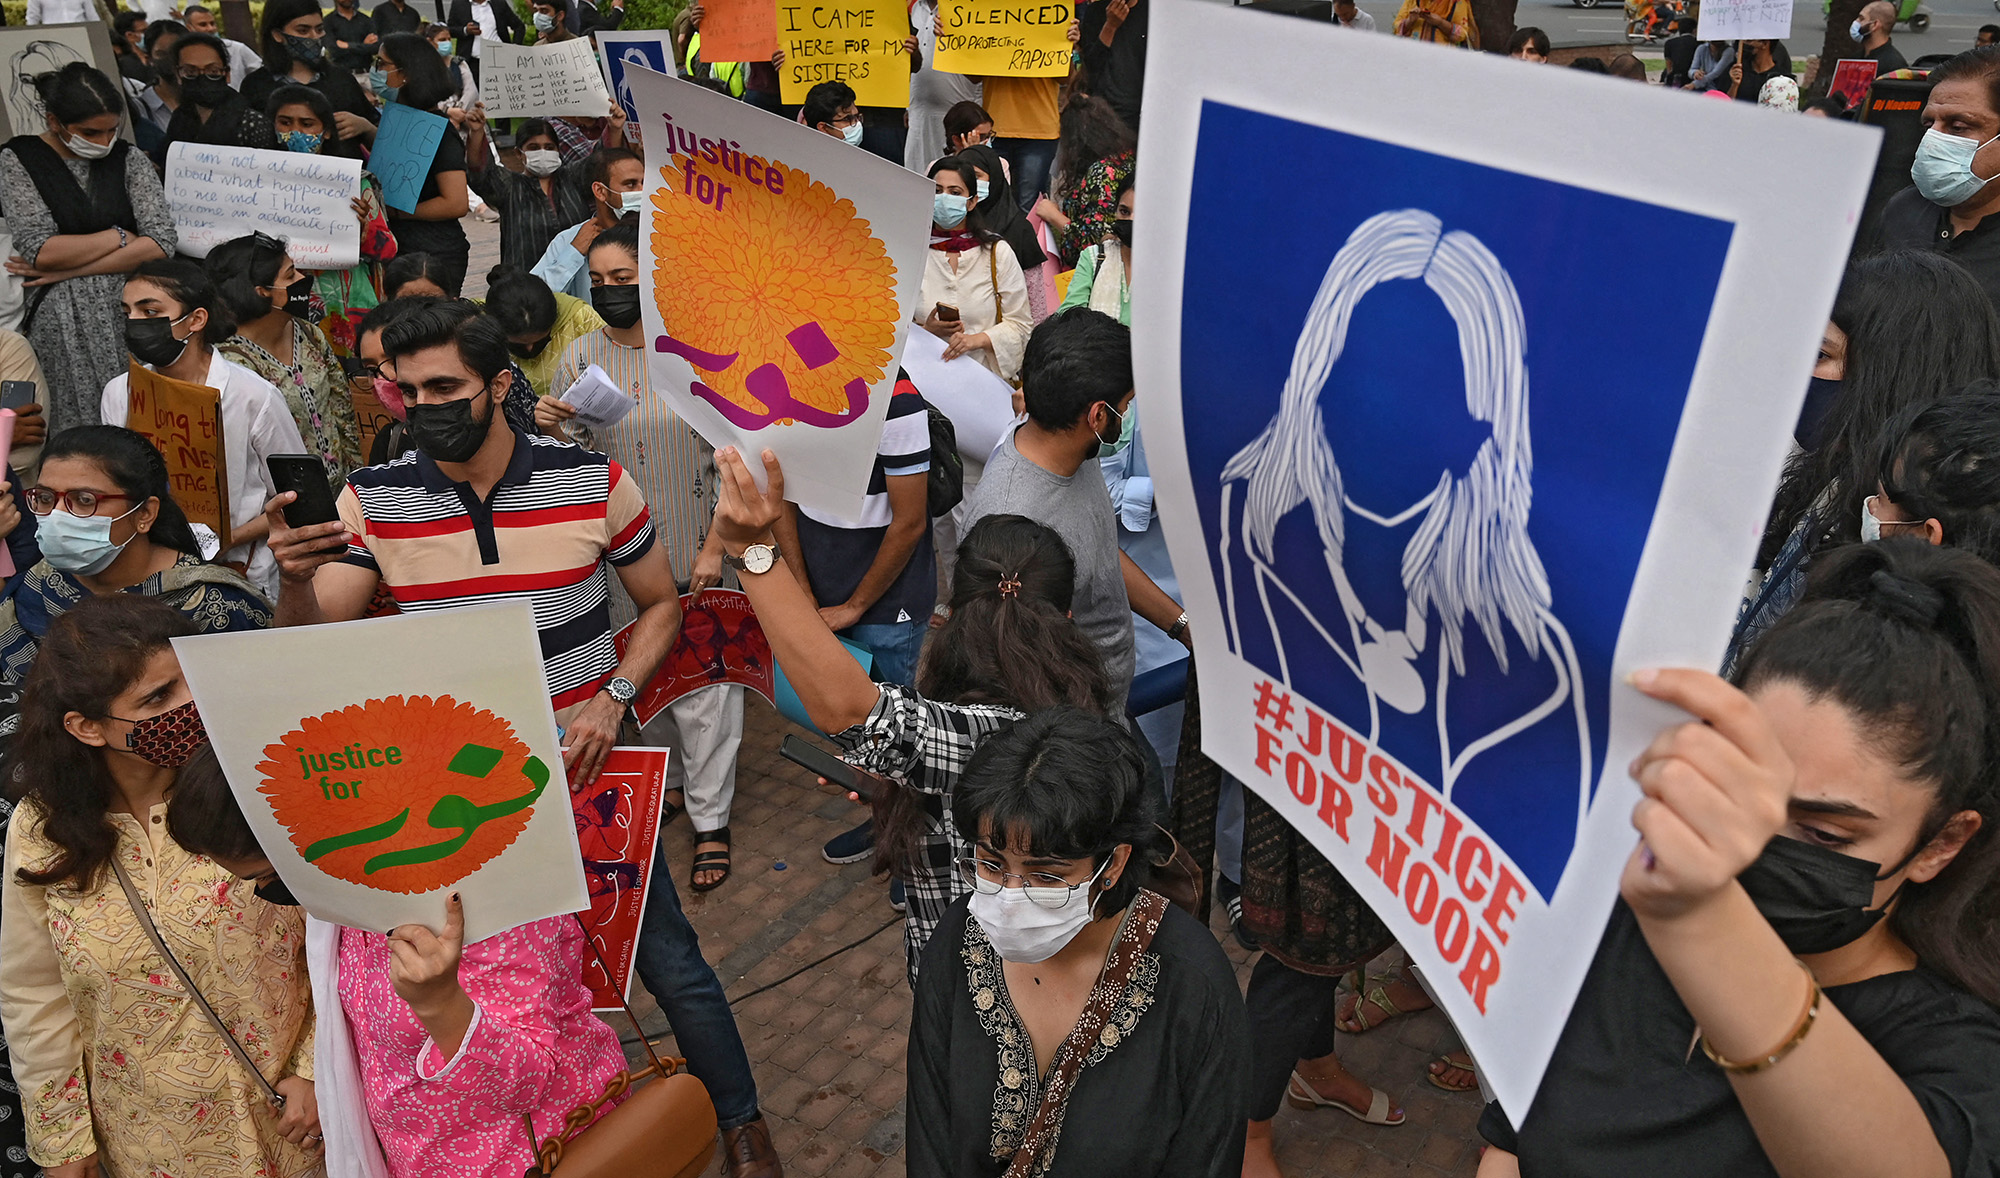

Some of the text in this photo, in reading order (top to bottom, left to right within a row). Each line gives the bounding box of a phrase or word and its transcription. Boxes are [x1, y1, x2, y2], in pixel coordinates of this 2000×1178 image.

[782, 6, 802, 32] I
[812, 6, 875, 29] CAME
[949, 4, 1069, 28] SILENCED
[486, 40, 591, 71] I AM WITH HE
[790, 38, 906, 59] HERE FOR MY
[937, 34, 1026, 51] STOP PROTECTING
[793, 62, 870, 84] SISTERS
[1008, 49, 1070, 70] RAPISTS
[485, 75, 499, 83] and
[504, 73, 523, 84] HER
[547, 70, 567, 80] HER
[505, 84, 525, 95] HER
[550, 79, 568, 88] HER
[485, 104, 501, 112] and
[509, 102, 527, 112] HER
[508, 94, 526, 103] HER
[552, 88, 569, 97] HER
[630, 131, 641, 140] FO
[176, 144, 355, 192] I am not at all shy
[661, 112, 785, 196] justice
[174, 166, 349, 202] about what happened
[682, 159, 732, 212] for
[172, 182, 323, 216] to me and I have
[170, 199, 354, 235] become an advocate for
[654, 320, 870, 432] نور
[150, 380, 191, 447] long
[198, 406, 217, 439] ti
[170, 473, 208, 492] TAG
[295, 742, 403, 780] justice
[319, 776, 363, 800] for
[303, 742, 550, 876] نور
[1253, 679, 1527, 947] #JUSTICE
[1254, 722, 1501, 1017] FOR NOOR
